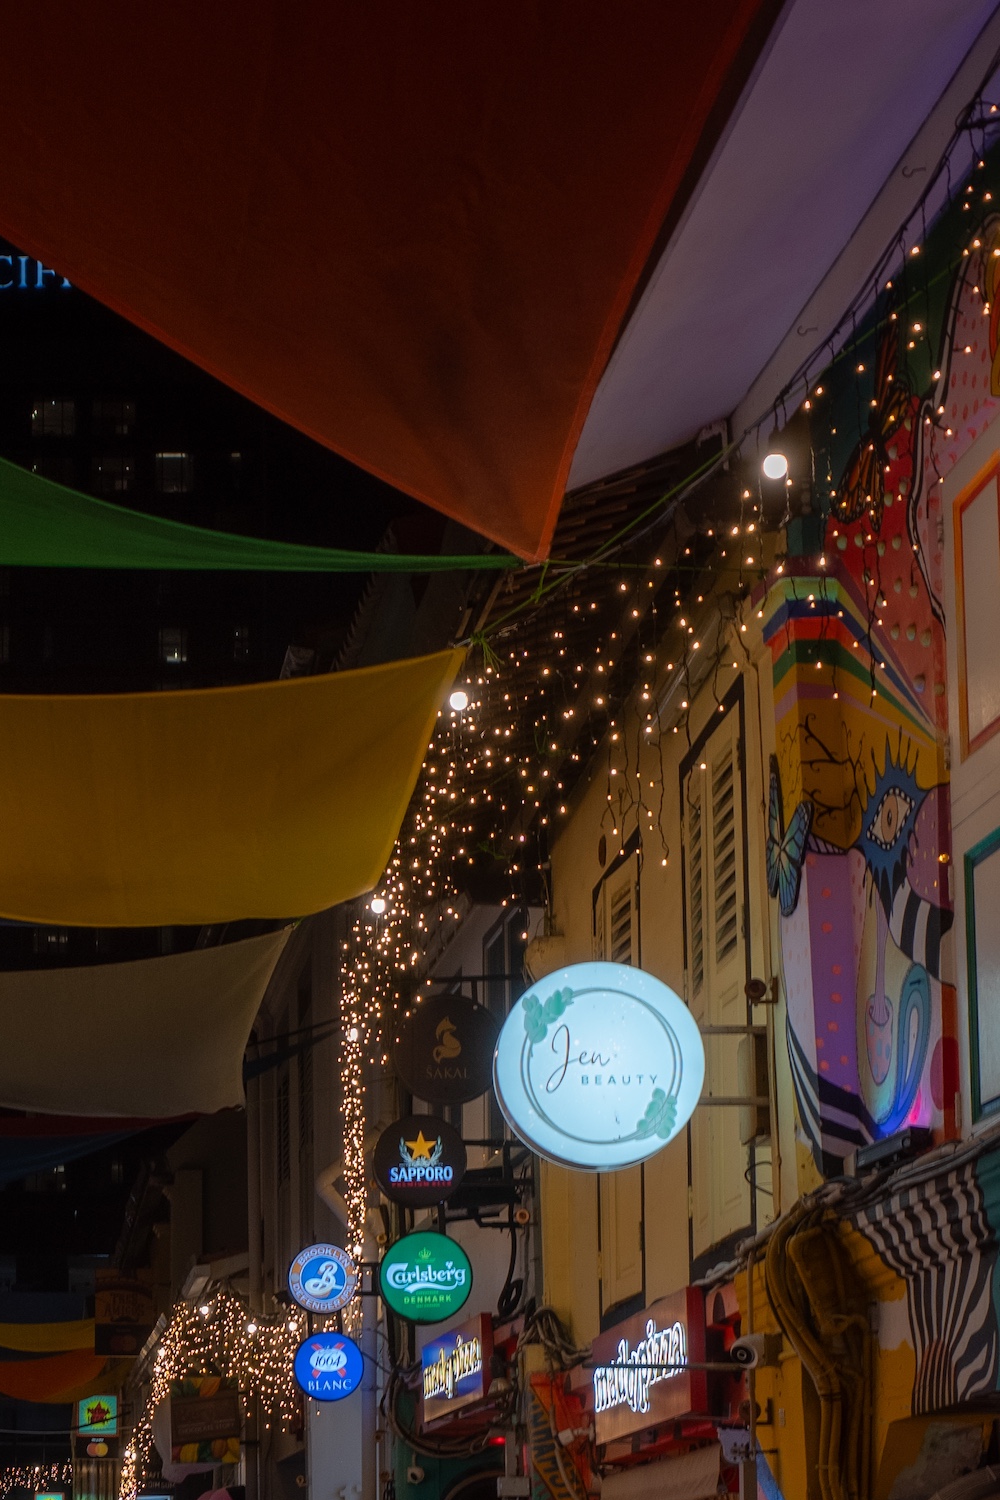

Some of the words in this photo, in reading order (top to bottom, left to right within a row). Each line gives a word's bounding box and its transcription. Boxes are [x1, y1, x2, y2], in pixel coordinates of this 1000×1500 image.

[546, 1024, 611, 1094] Jen
[580, 1074, 658, 1086] BEAUTY
[389, 1165, 454, 1183] SAPPORO
[297, 1246, 350, 1266] BROOKLYN
[386, 1261, 466, 1294] Carlsberg
[292, 1282, 341, 1310] DEFENDER
[403, 1294, 452, 1305] DENMARK
[315, 1353, 342, 1368] 1664
[308, 1379, 352, 1391] BLANC
